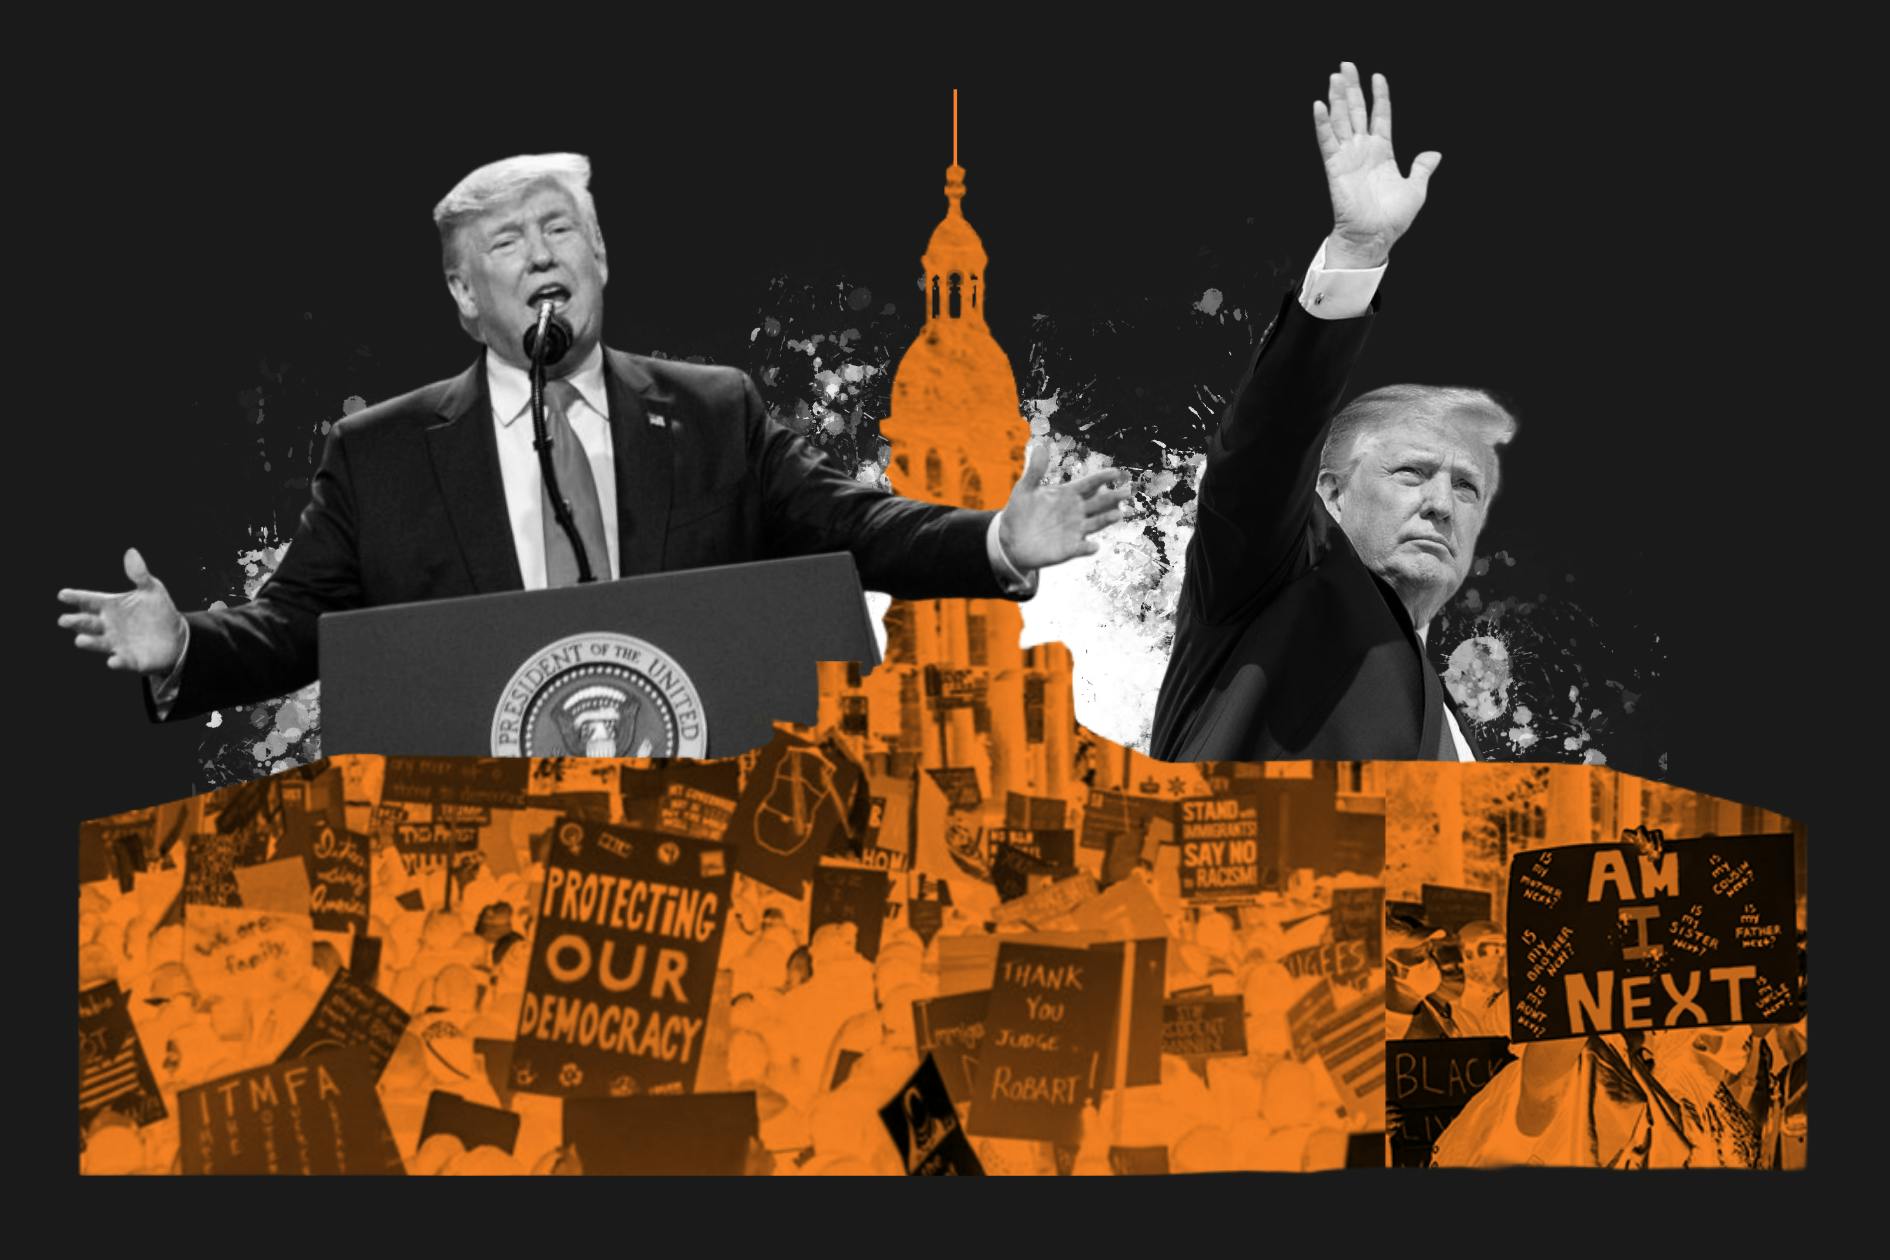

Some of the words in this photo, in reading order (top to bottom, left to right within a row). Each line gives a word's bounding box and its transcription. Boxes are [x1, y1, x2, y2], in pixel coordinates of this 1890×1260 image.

[499, 643, 582, 745] PRESIDENT
[590, 643, 610, 657] OF
[614, 646, 641, 664] THE
[650, 658, 700, 741] UNITED
[1184, 800, 1238, 821] STAND
[1184, 842, 1225, 868] SAY
[1229, 839, 1257, 865] NO
[1587, 850, 1680, 902] AM
[1618, 905, 1664, 960] I
[1669, 920, 1719, 950] SISTER
[1735, 924, 1781, 938] FATHER
[545, 932, 690, 1005] OUR
[1004, 961, 1084, 991] THANK
[1563, 965, 1757, 1034] NEXT
[518, 990, 703, 1063] DEMOCRACY
